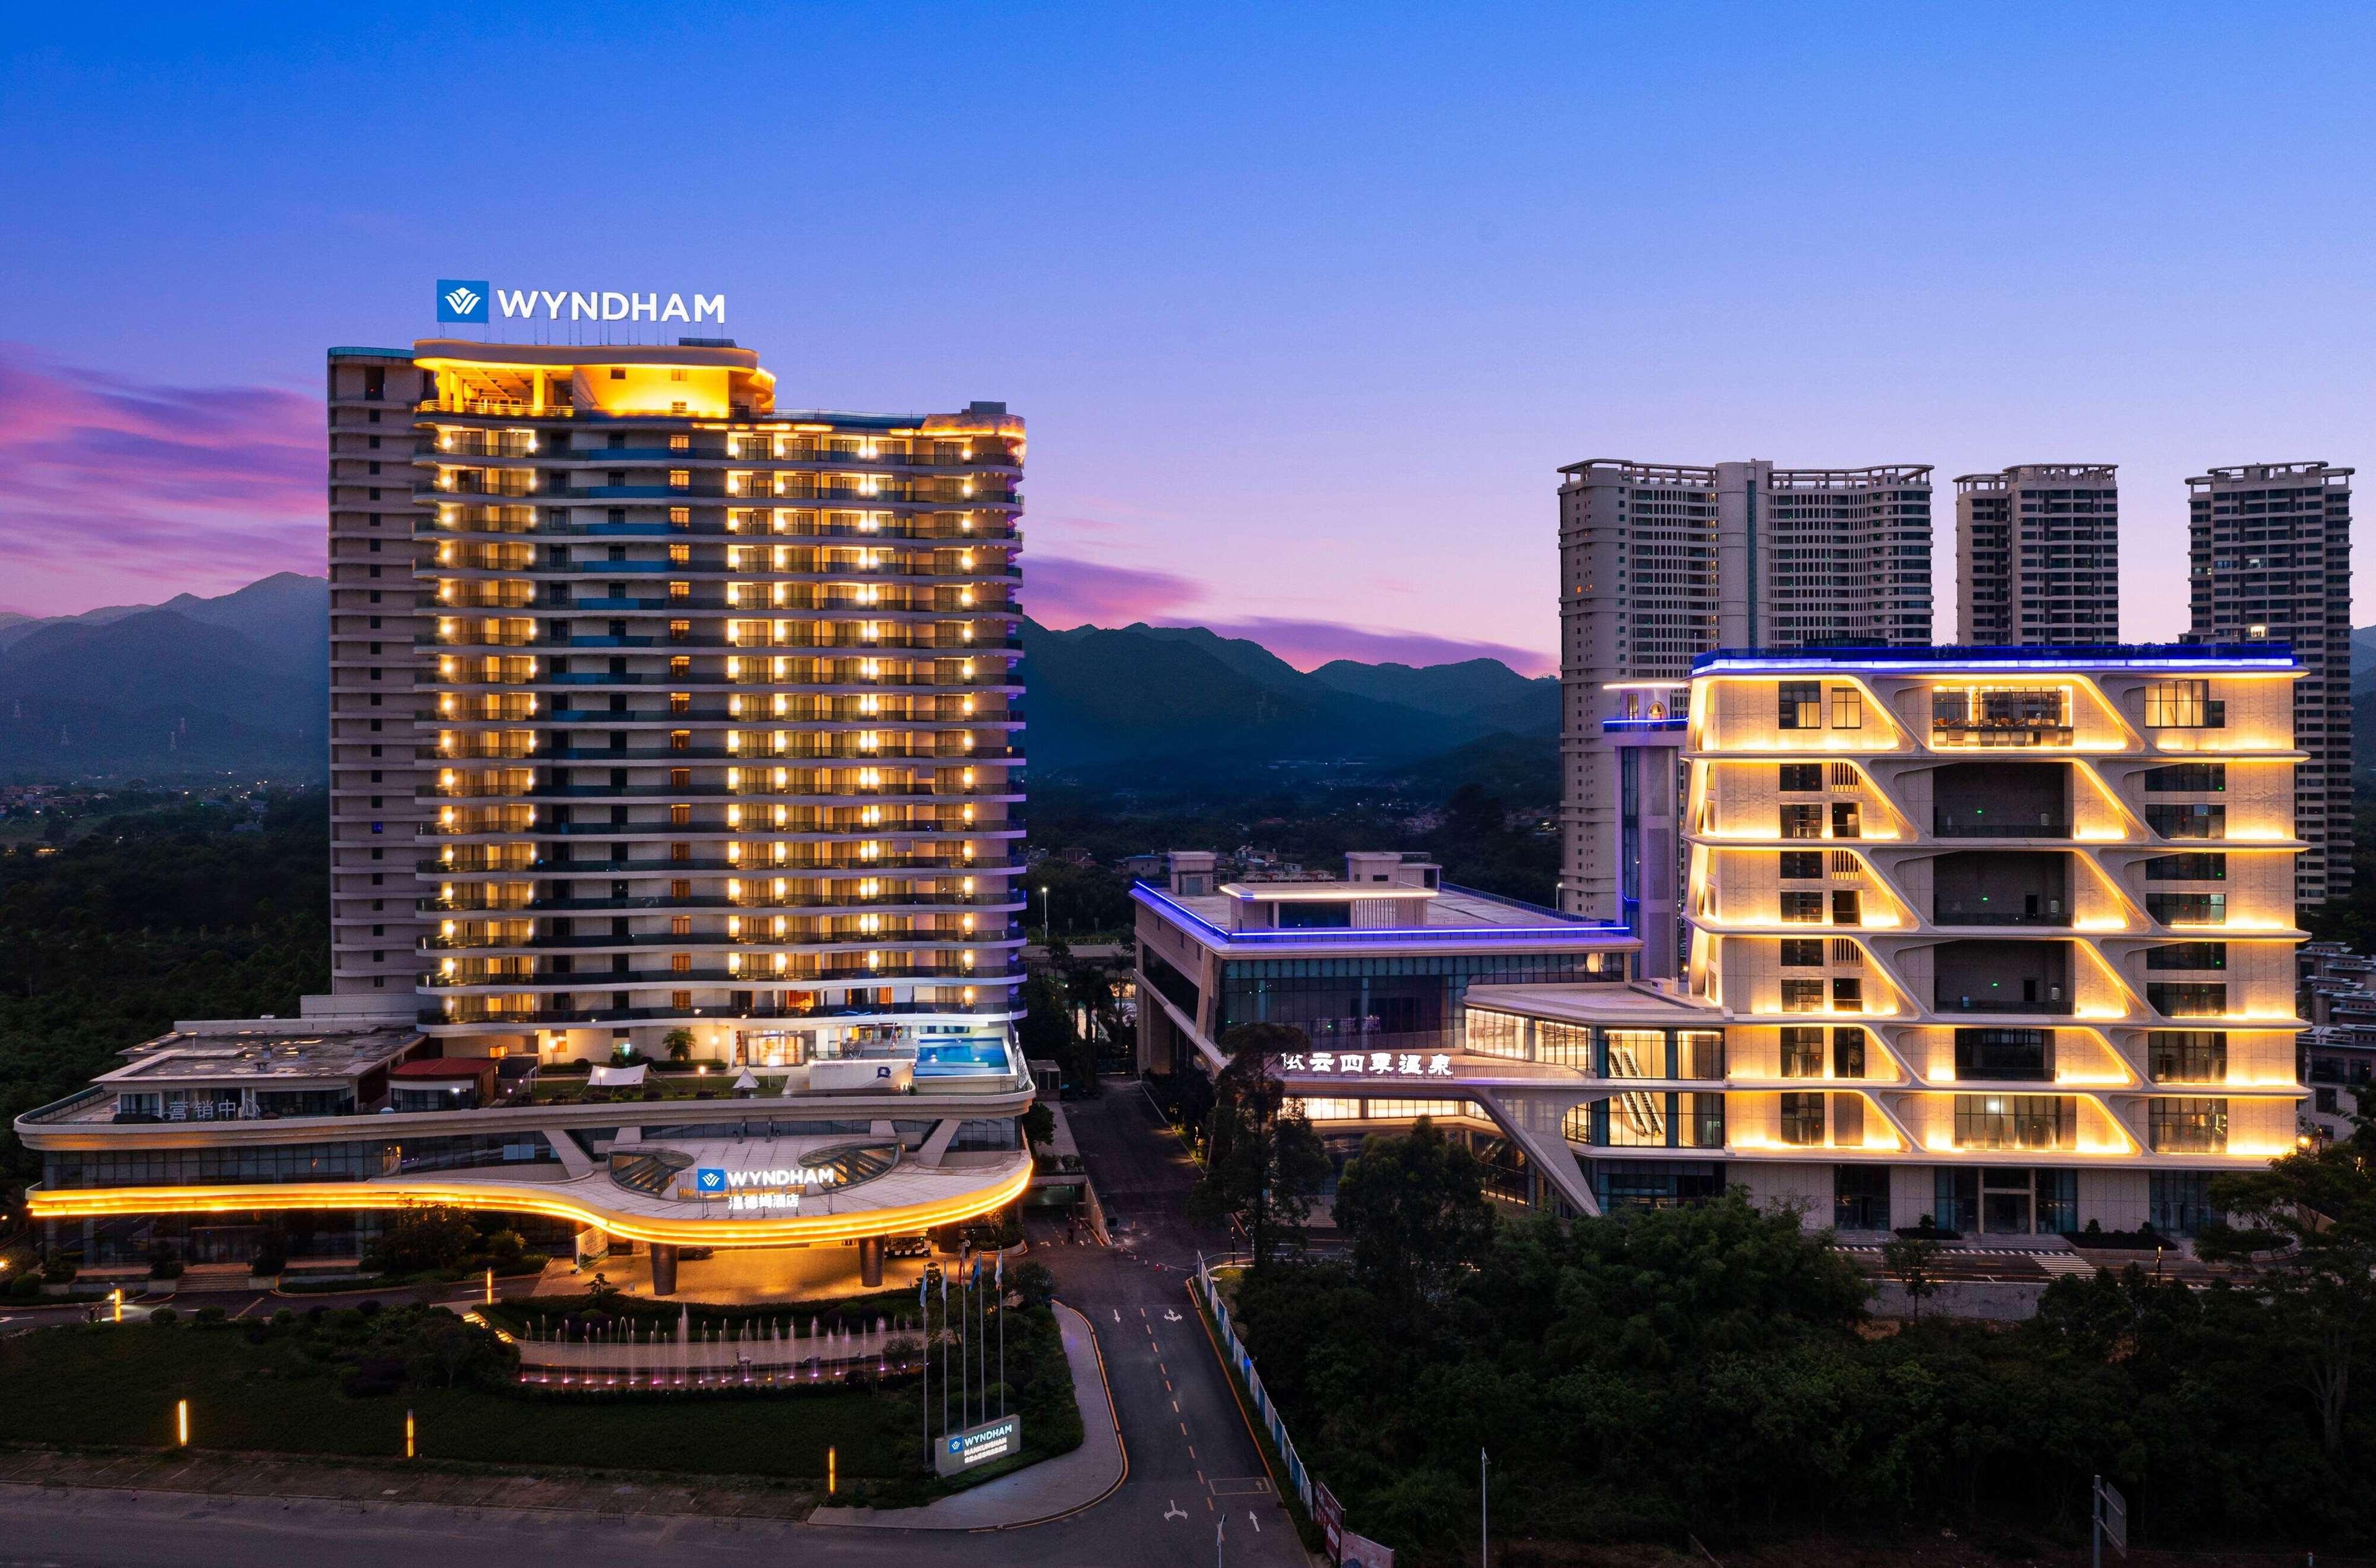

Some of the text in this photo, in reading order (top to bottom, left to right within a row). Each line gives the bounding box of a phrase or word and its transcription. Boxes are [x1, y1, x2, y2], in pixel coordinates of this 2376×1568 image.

[496, 290, 725, 324] WYNDHAM
[727, 1168, 834, 1187] WYNDHAM
[964, 1424, 1012, 1447] WYNDHAM
